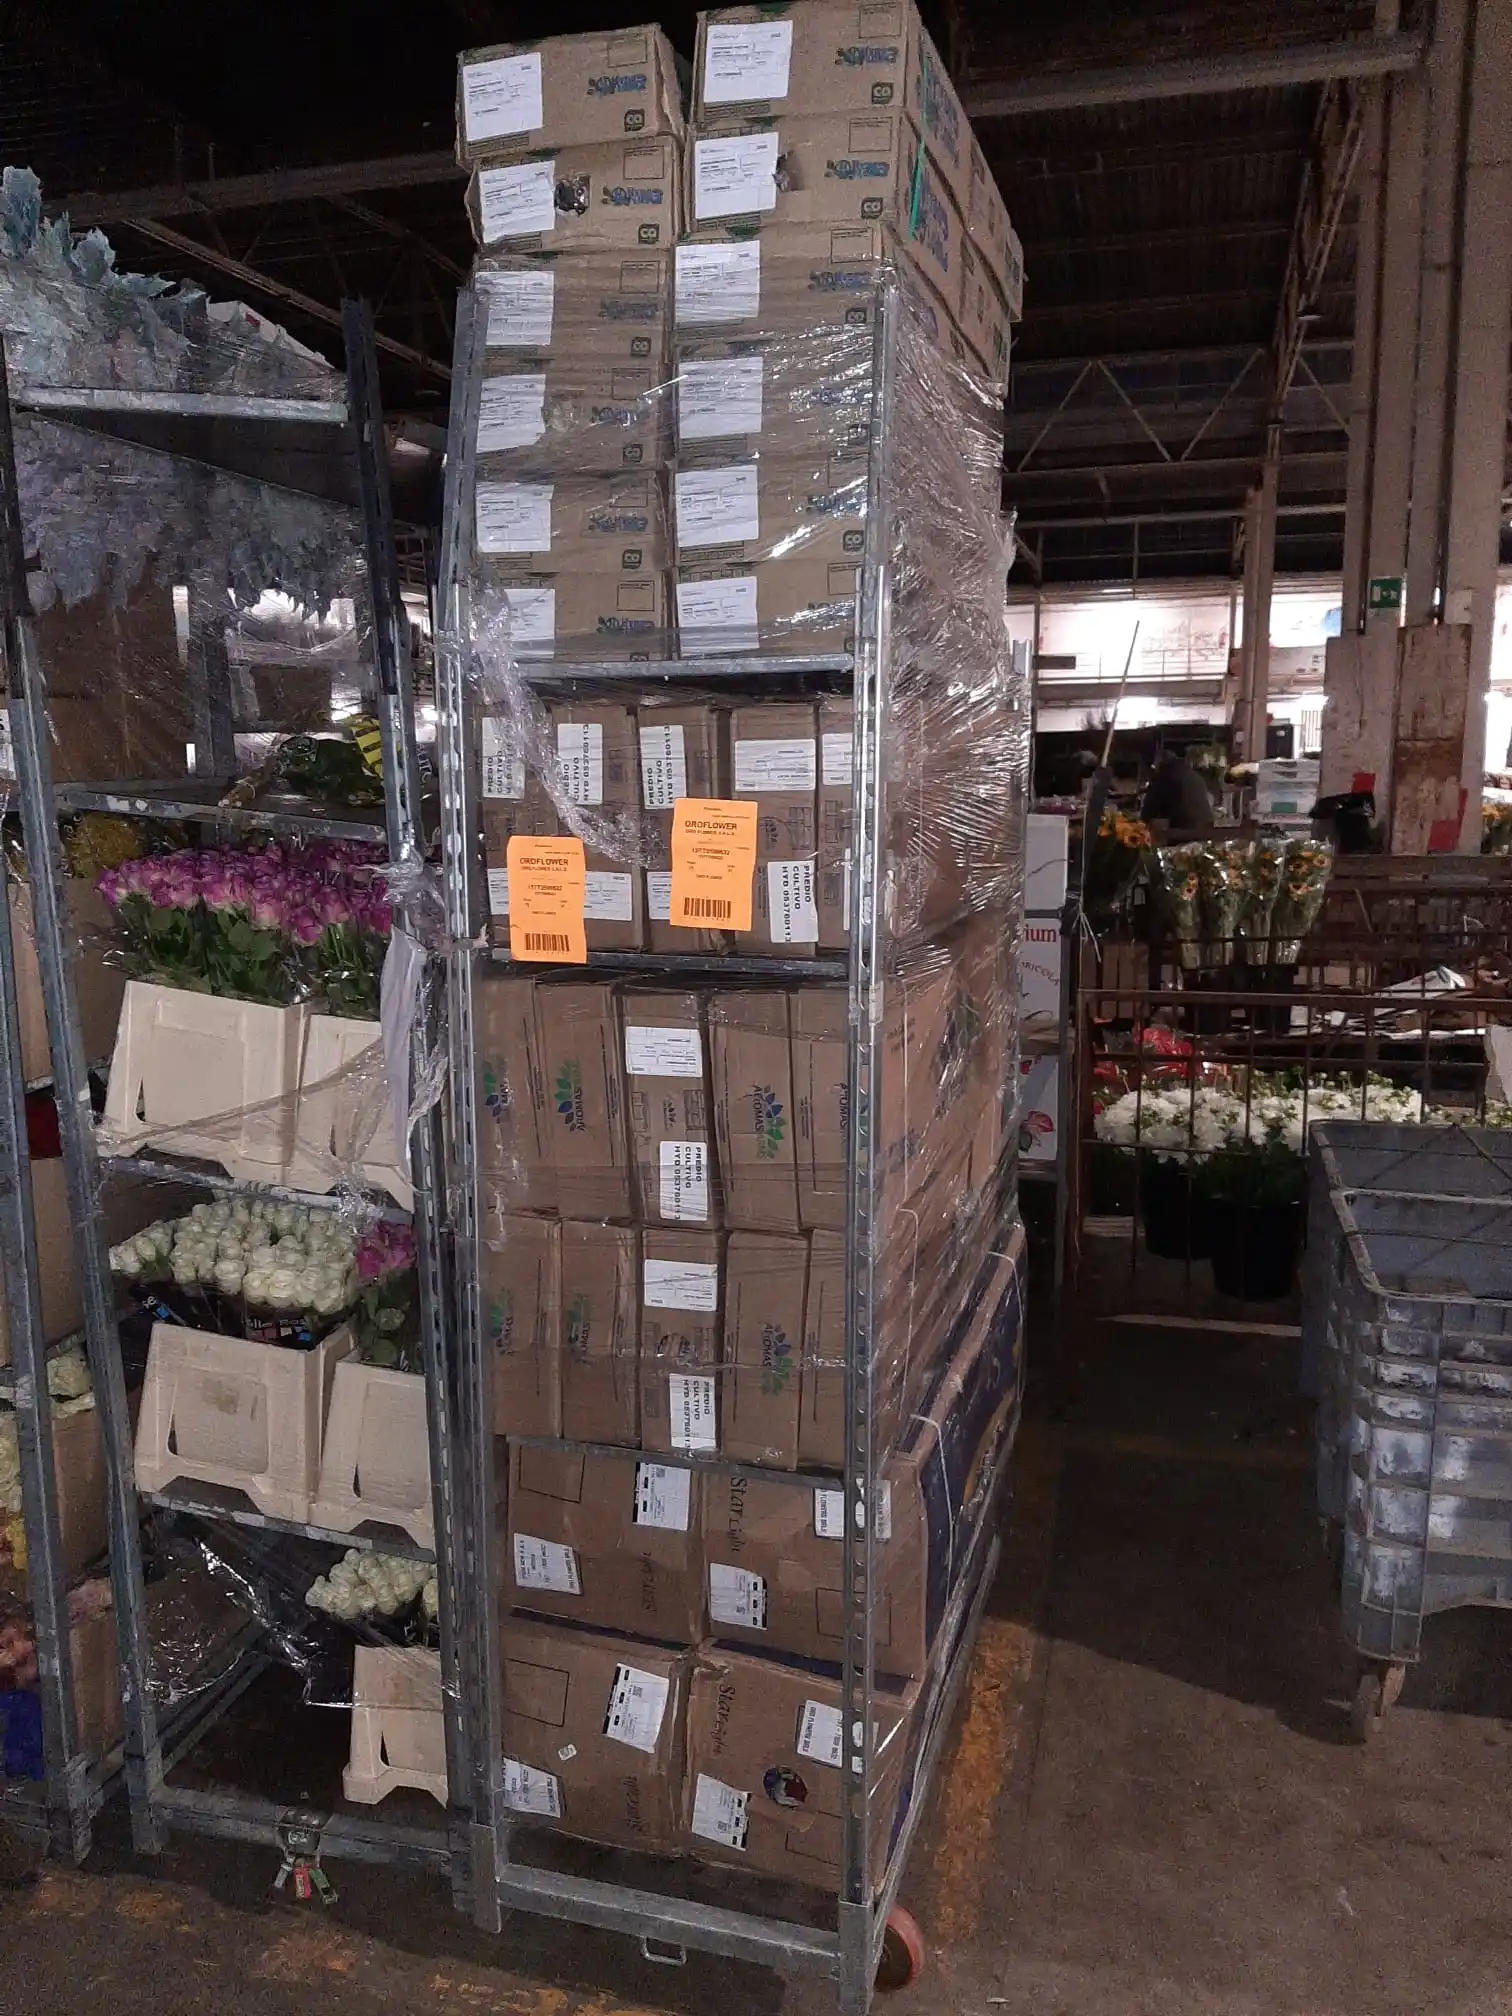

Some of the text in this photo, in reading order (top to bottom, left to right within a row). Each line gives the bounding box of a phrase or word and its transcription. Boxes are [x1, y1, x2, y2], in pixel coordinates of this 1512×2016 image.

[793, 865, 801, 910] CULTIVO
[803, 865, 812, 903] PREDIO
[1025, 924, 1057, 943] ium
